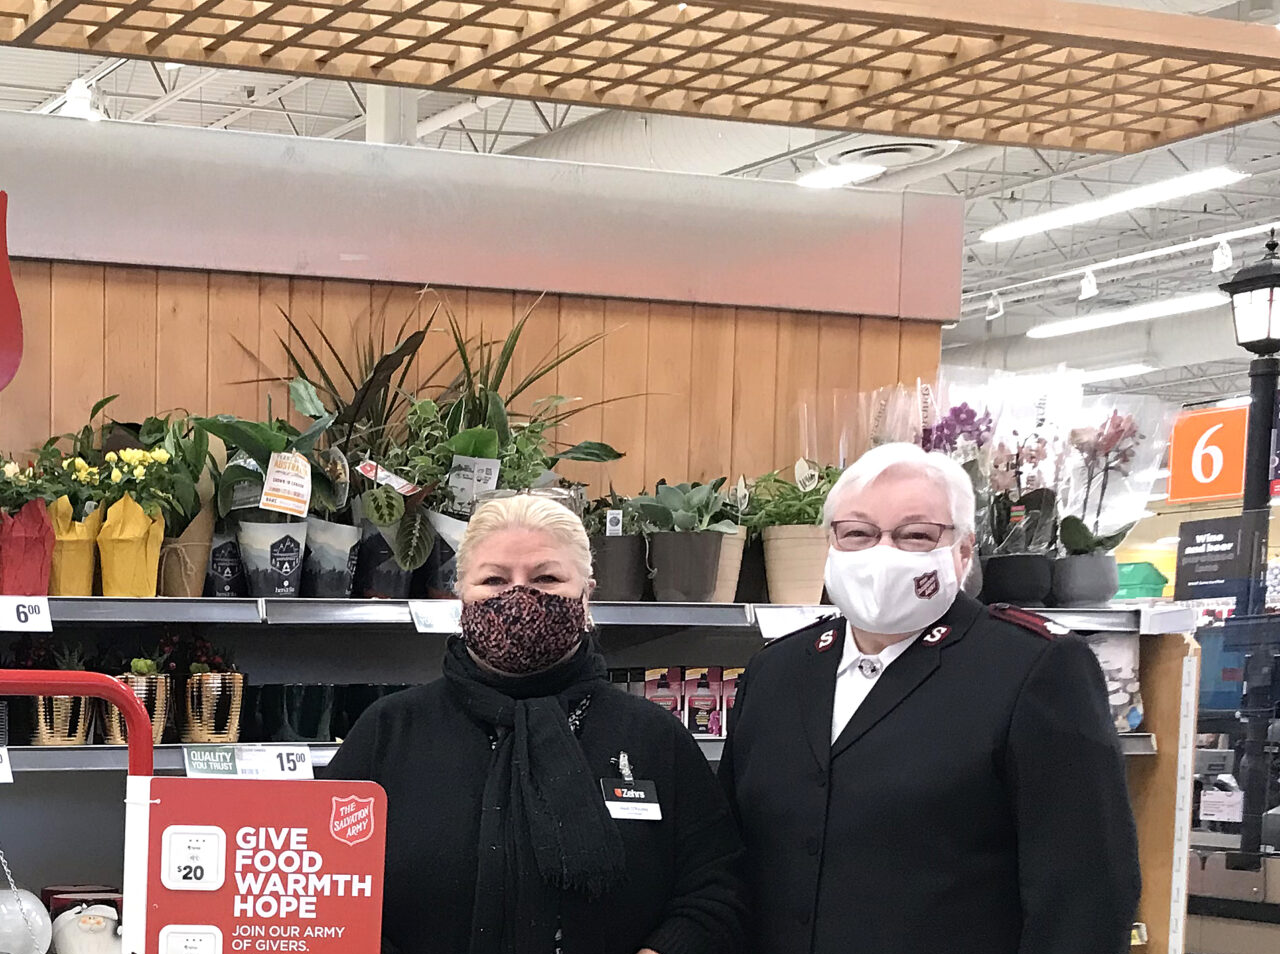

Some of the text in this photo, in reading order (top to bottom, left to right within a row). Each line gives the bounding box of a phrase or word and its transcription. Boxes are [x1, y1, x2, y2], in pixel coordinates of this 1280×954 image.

[1191, 423, 1223, 484] 6
[191, 750, 232, 762] QUALITY
[192, 761, 233, 771] YOU TRUST
[622, 789, 645, 798] Zehrs
[334, 805, 369, 831] SALVATION
[340, 802, 356, 816] THE
[346, 818, 369, 838] ARMY
[236, 827, 308, 850] GIVE
[235, 849, 323, 873] FOOD
[177, 865, 204, 881] $20
[234, 873, 372, 897] WARMTH
[233, 896, 317, 919] HOPE
[232, 925, 345, 938] JOIN OUR ARMY
[232, 939, 310, 952] OF GIVERS.
